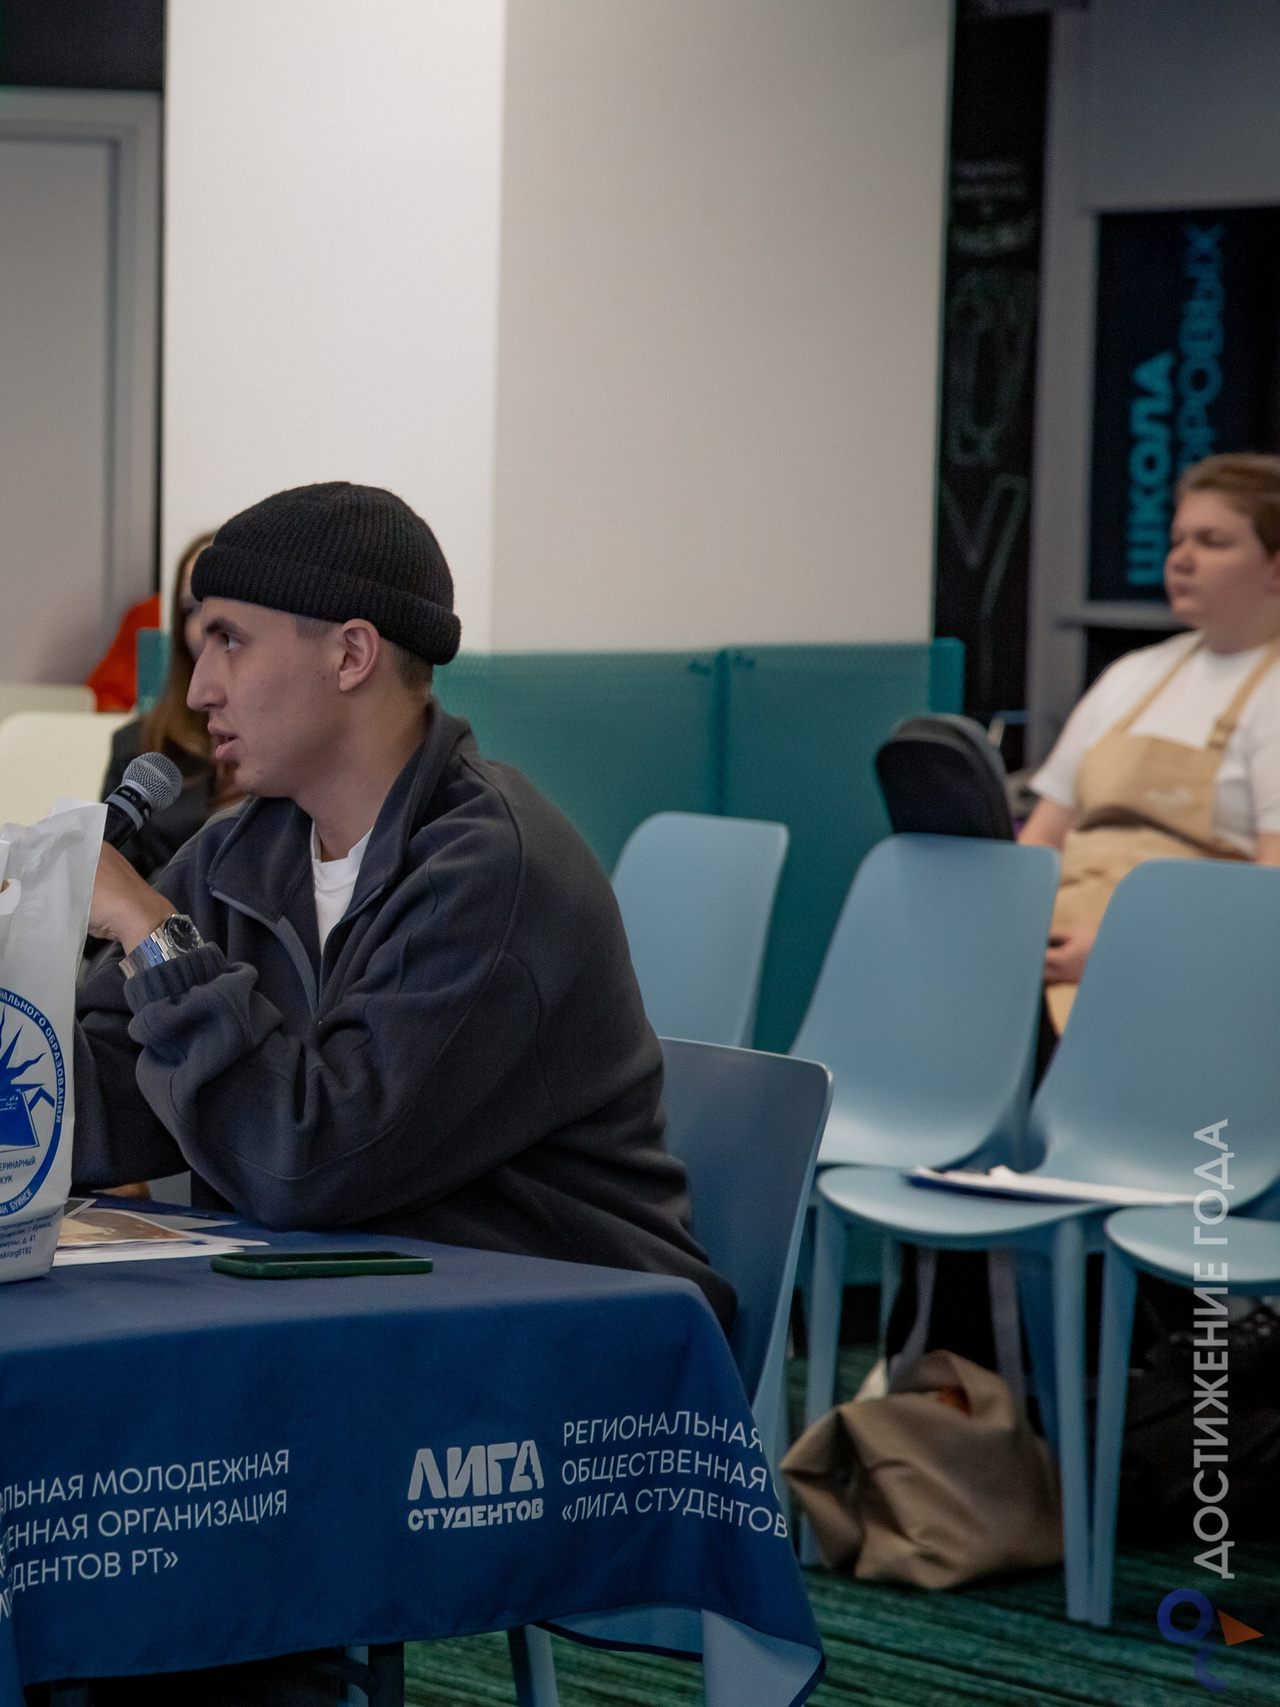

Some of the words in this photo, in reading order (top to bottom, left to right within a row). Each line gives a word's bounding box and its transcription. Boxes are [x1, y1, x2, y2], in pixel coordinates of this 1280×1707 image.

[1127, 350, 1174, 585] ШКОЛА
[45, 1028, 64, 1123] ОБРАЗОВАНИЯ
[563, 1410, 763, 1452] РЕГИОНАЛЬНАЯ
[92, 1449, 289, 1497] МОЛОДЕЖНАЯ
[407, 1439, 545, 1501] ЛИГА
[561, 1449, 767, 1492] ОБЩЕСТВЕННАЯ
[98, 1489, 287, 1537] ОРГАНИЗАЦИЯ
[407, 1497, 544, 1531] СТУДЕНТОВ
[562, 1492, 628, 1523] «ЛИГА
[635, 1487, 788, 1538] СТУДЕНТОВ
[131, 1547, 179, 1576] РТ»
